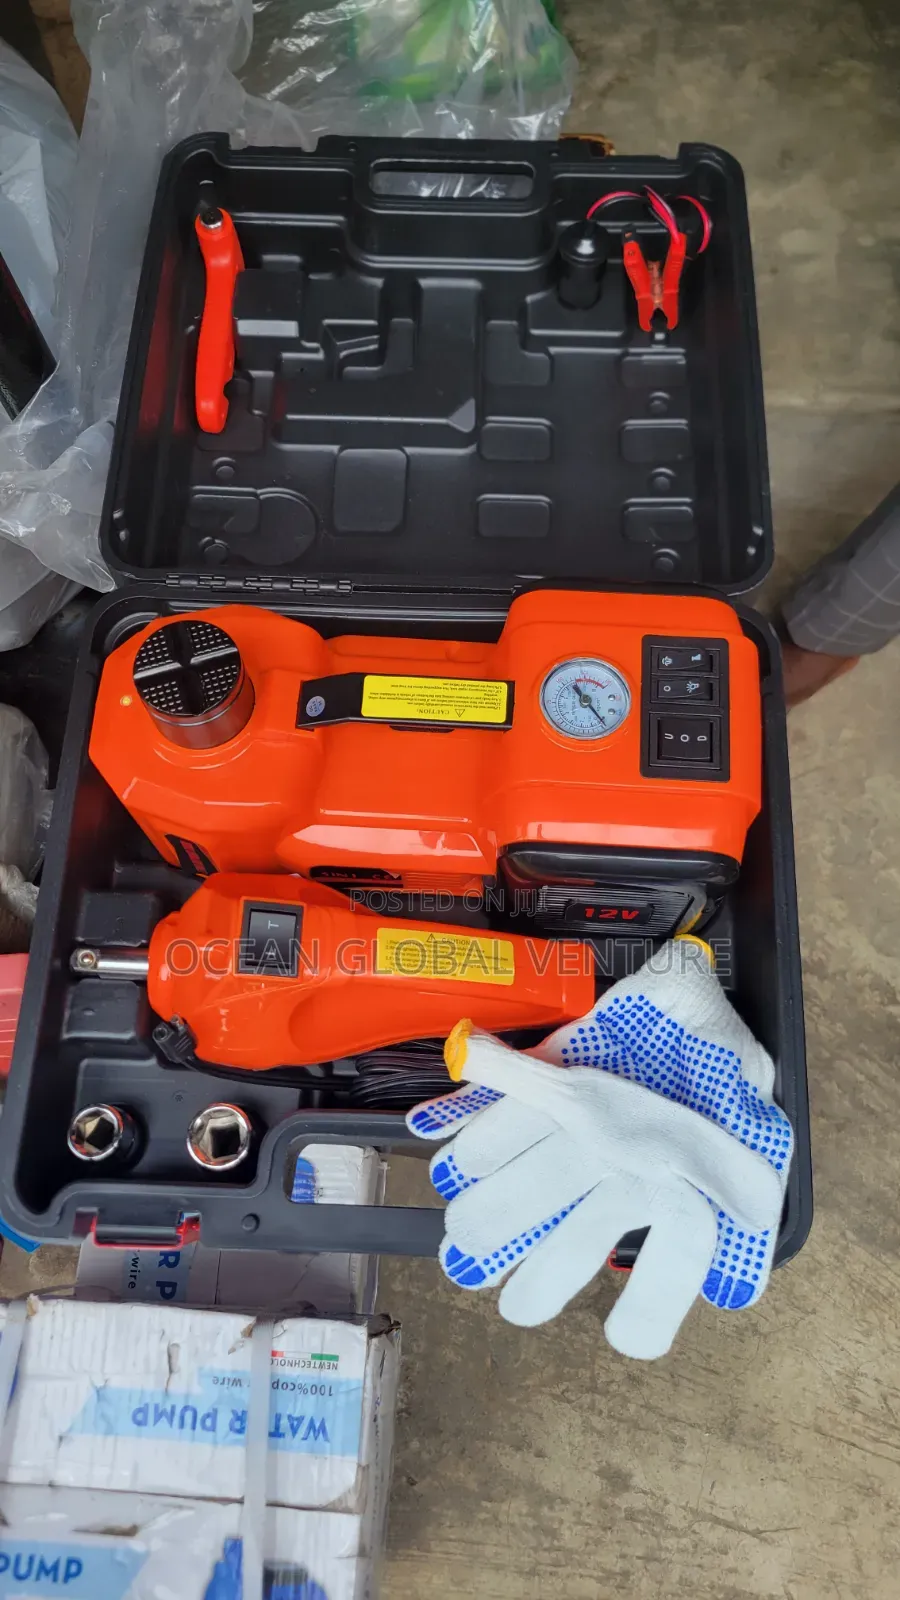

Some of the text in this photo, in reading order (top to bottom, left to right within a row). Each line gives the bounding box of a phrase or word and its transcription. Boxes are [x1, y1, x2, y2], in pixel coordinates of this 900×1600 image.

[584, 907, 640, 920] 12V
[128, 1256, 140, 1290] wire
[271, 1358, 338, 1370] NEWTECHNOL
[212, 1375, 334, 1397] 100%cop wire
[132, 1403, 330, 1442] WATR PUMP
